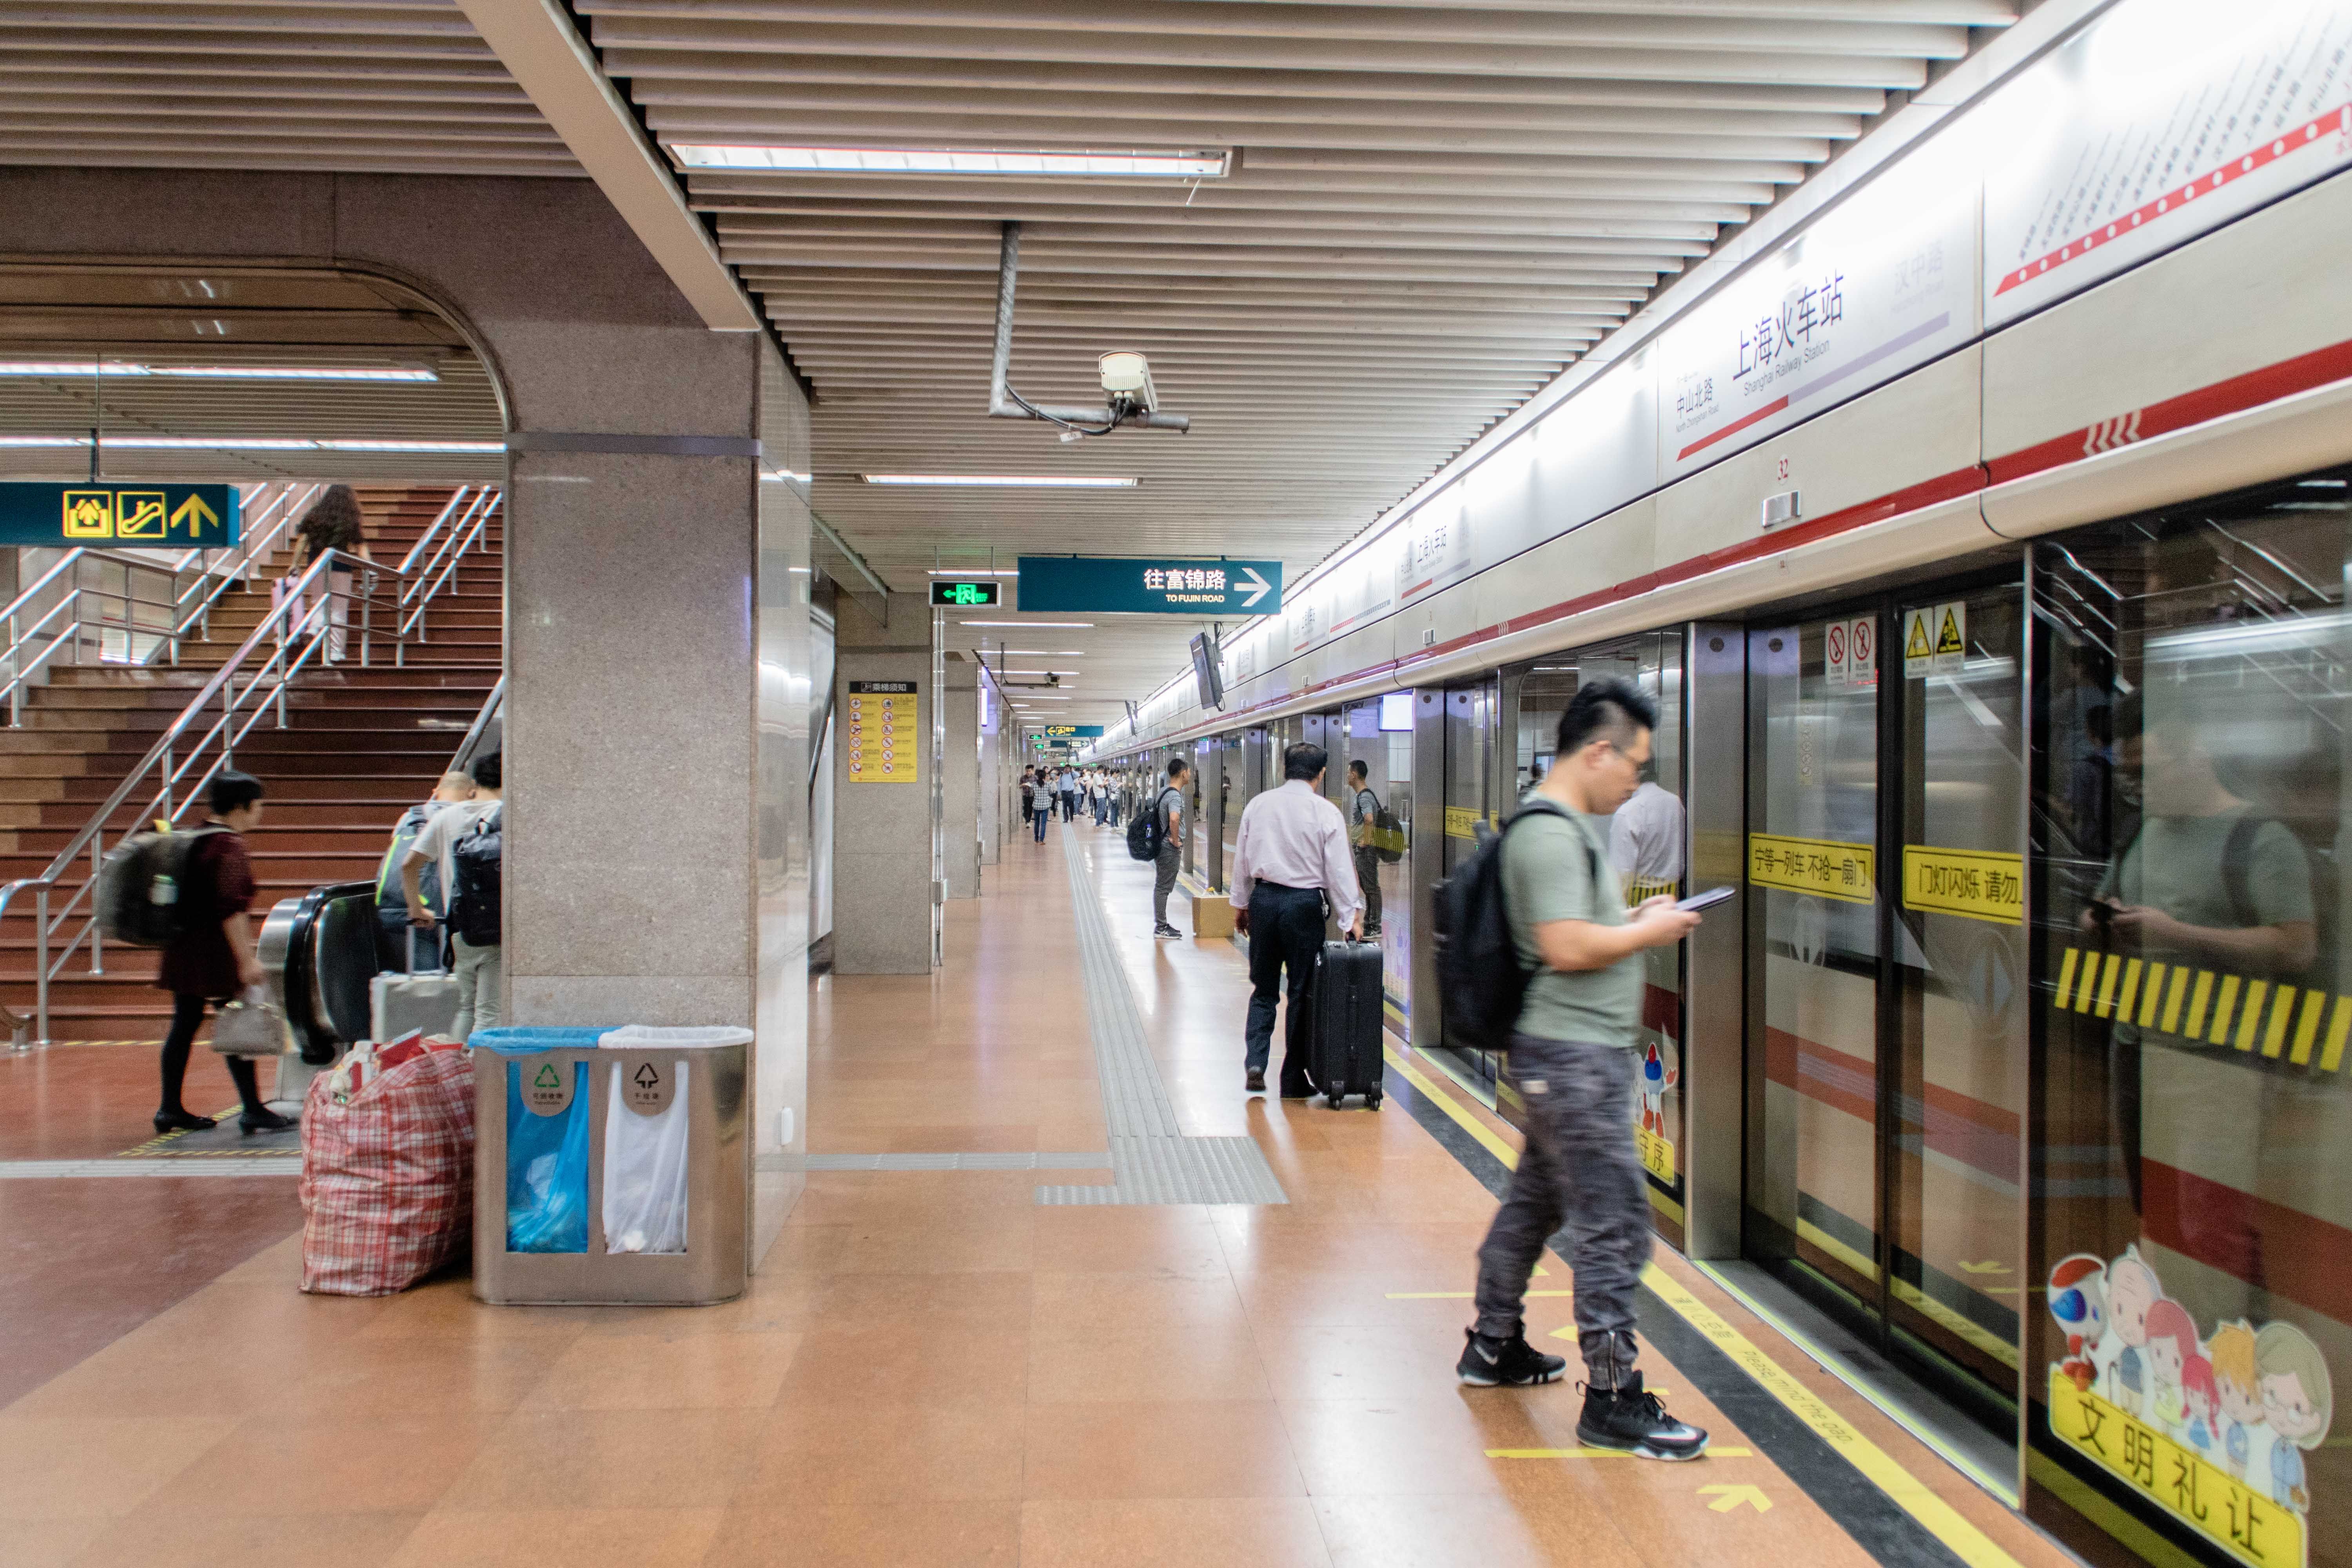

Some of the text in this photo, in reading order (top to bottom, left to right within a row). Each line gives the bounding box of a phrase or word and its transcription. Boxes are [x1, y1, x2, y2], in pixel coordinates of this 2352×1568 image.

[1733, 268, 1844, 381] 上海火车站
[1744, 339, 1830, 396] Shanghai Railway Station
[1677, 376, 1713, 419] 中山北路
[1777, 458, 1788, 481] 32
[1143, 569, 1226, 590] 往富锦路
[1165, 594, 1225, 603] TO FUJIN ROAD
[1755, 846, 1867, 887] 宁等一列车 不抢一扇门
[1920, 863, 2023, 904] 门灯闪烁 请勿
[1771, 1379, 1809, 1402] mind
[2078, 1398, 2264, 1559] 文明礼让
